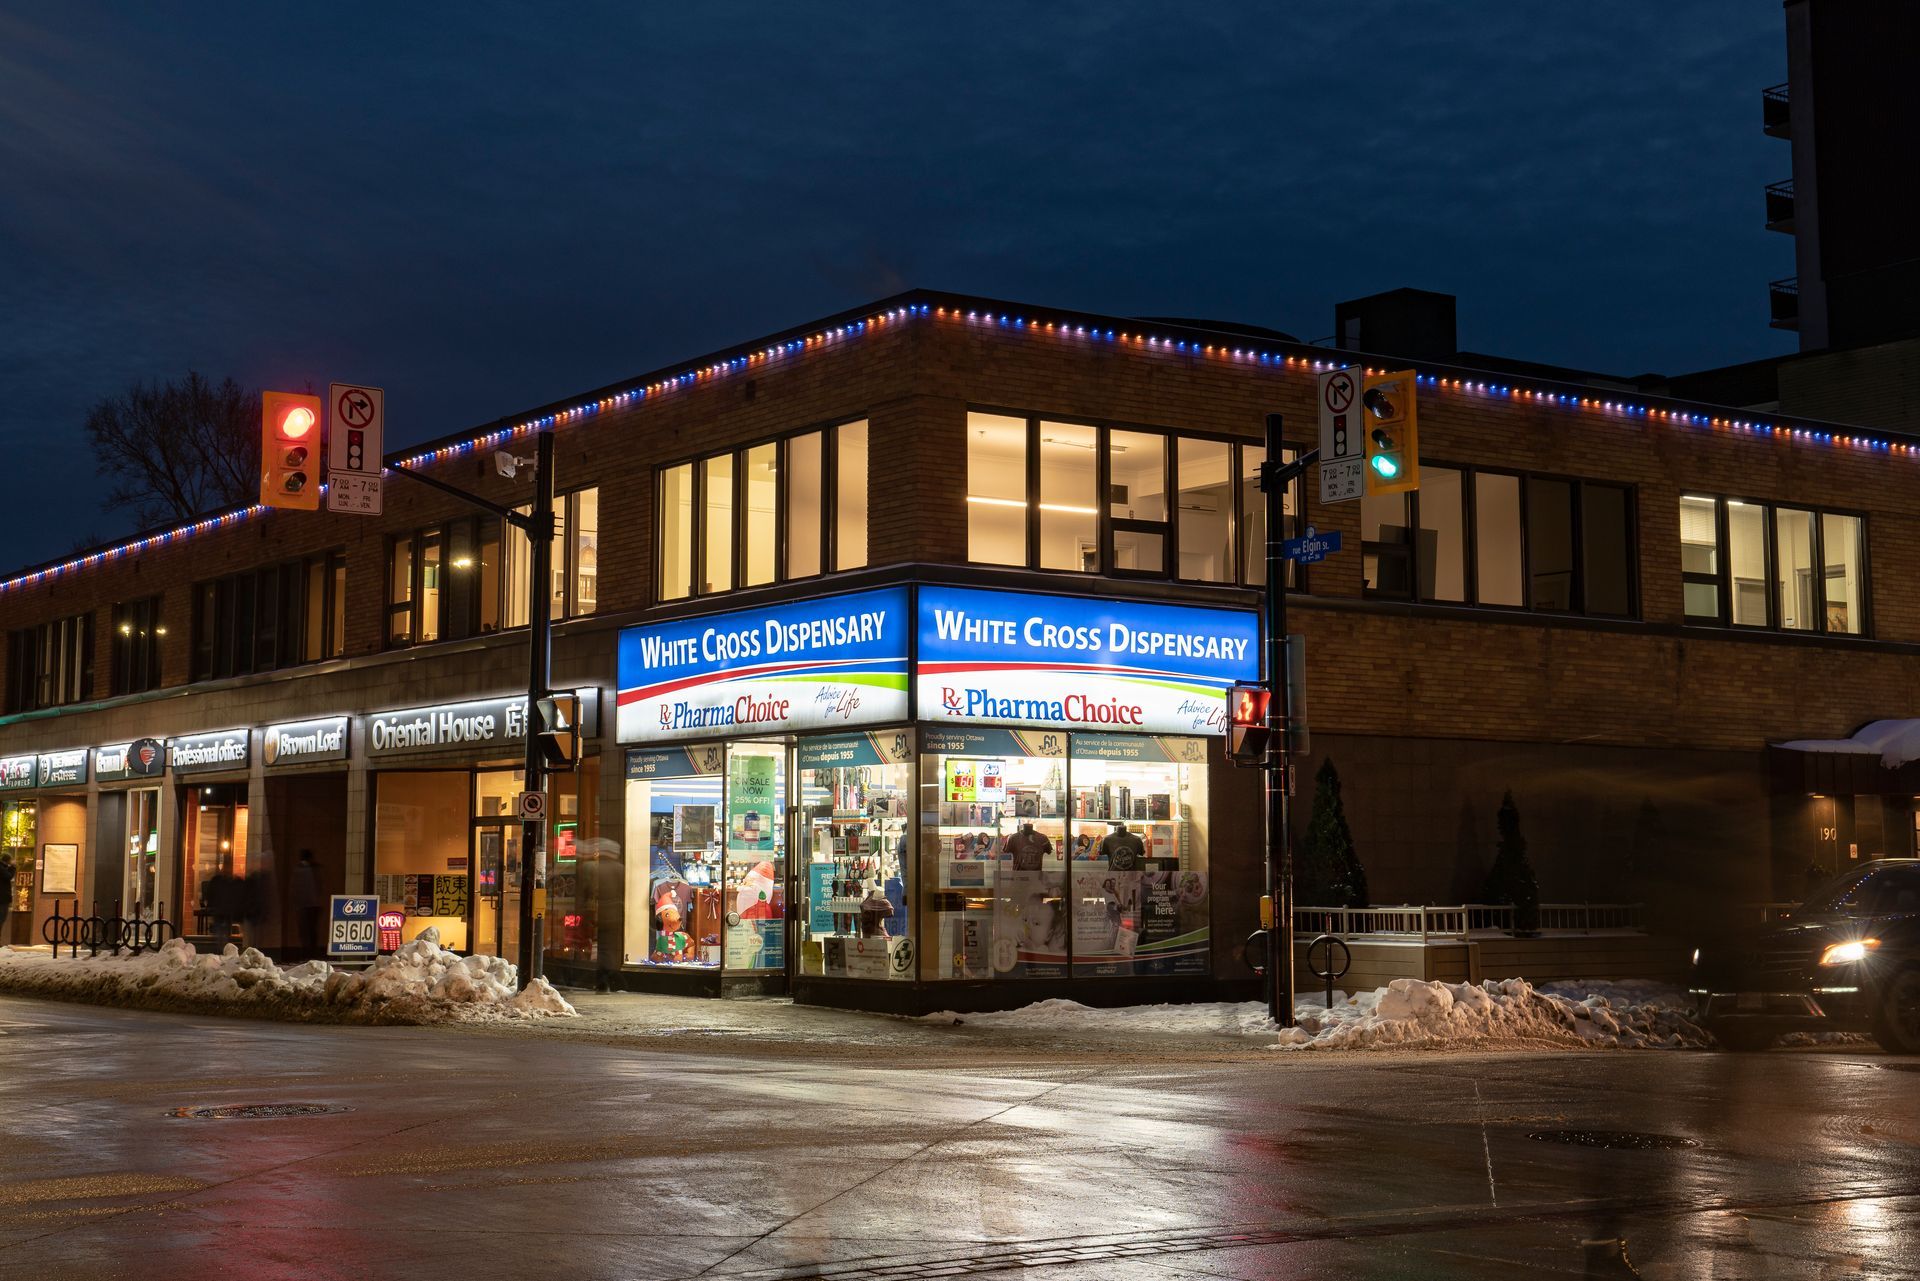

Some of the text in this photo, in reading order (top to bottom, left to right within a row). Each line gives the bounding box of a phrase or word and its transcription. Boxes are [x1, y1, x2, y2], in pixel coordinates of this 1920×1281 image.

[1323, 470, 1327, 480] 7
[1346, 465, 1351, 477] 7
[332, 478, 337, 489] 7
[361, 481, 366, 492] 7
[1292, 547, 1301, 555] rue
[1303, 539, 1321, 556] Elgin
[815, 685, 841, 704] Advice
[824, 687, 861, 719] for Life
[965, 689, 1143, 725] PharmaChoice
[1177, 700, 1211, 715] Advice
[672, 693, 789, 729] PharmaChoice
[1193, 706, 1227, 733] for Lif
[372, 712, 495, 750] Oriental House
[926, 732, 985, 742] Proudly serving Ottawa
[281, 725, 343, 755] Brown Loaf
[927, 741, 965, 750] since 1955
[1083, 739, 1100, 747] service
[1100, 739, 1107, 747] de
[172, 738, 247, 767] Professional offices
[808, 743, 822, 751] service
[1075, 747, 1139, 758] d'Ottawa depuis 1955
[820, 752, 839, 763] depuis
[840, 750, 854, 760] 1955
[631, 764, 656, 774] since 1955
[735, 777, 770, 786] ON SALE
[742, 786, 763, 795] NOW
[735, 796, 770, 804] 25% OFF!
[1820, 827, 1837, 841] 190
[1151, 882, 1167, 891] Your
[1147, 896, 1170, 904] program
[1155, 906, 1176, 915] here.
[378, 915, 402, 928] OPEN
[339, 943, 363, 951] Million
